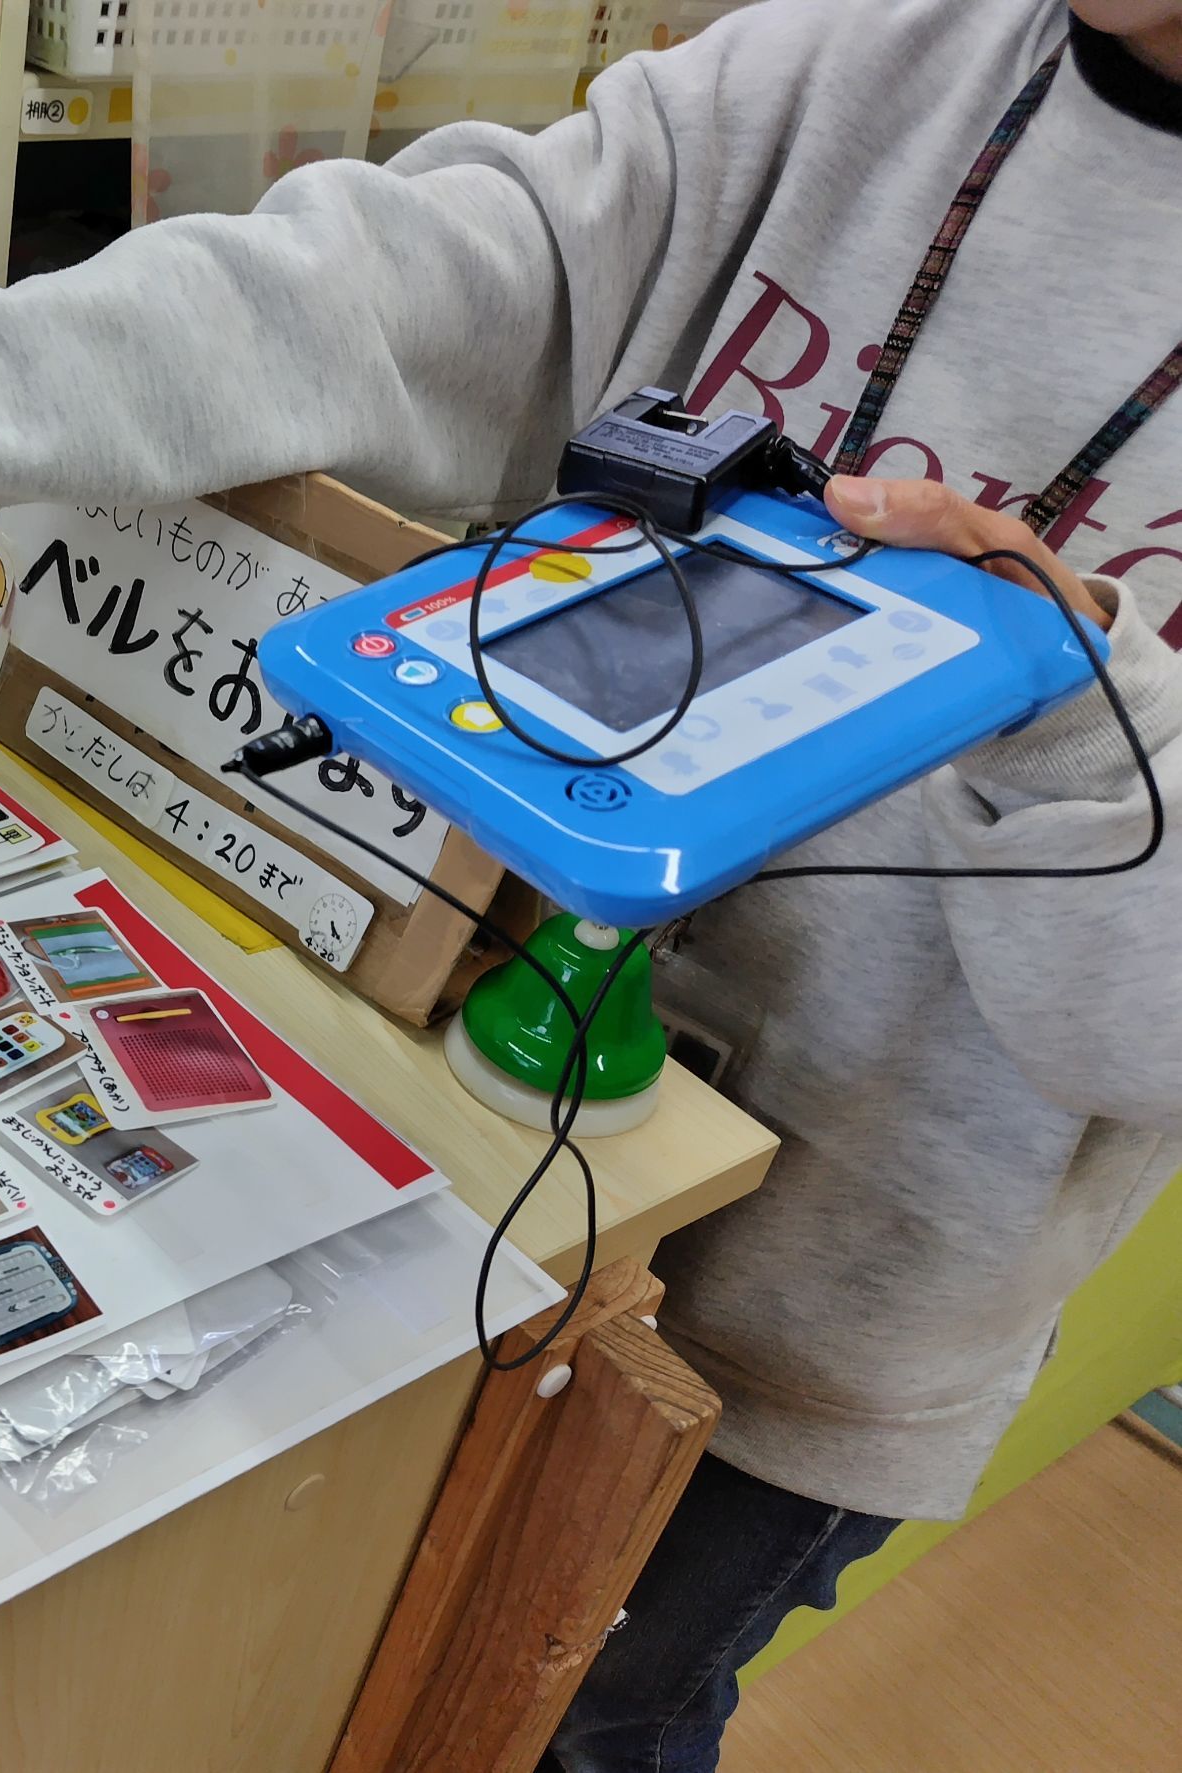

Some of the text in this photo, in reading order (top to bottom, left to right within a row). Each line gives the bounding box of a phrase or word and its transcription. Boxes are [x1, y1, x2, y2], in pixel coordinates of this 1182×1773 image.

[424, 596, 457, 613] 100%
[164, 799, 257, 874] 4:20
[258, 861, 305, 902] まで
